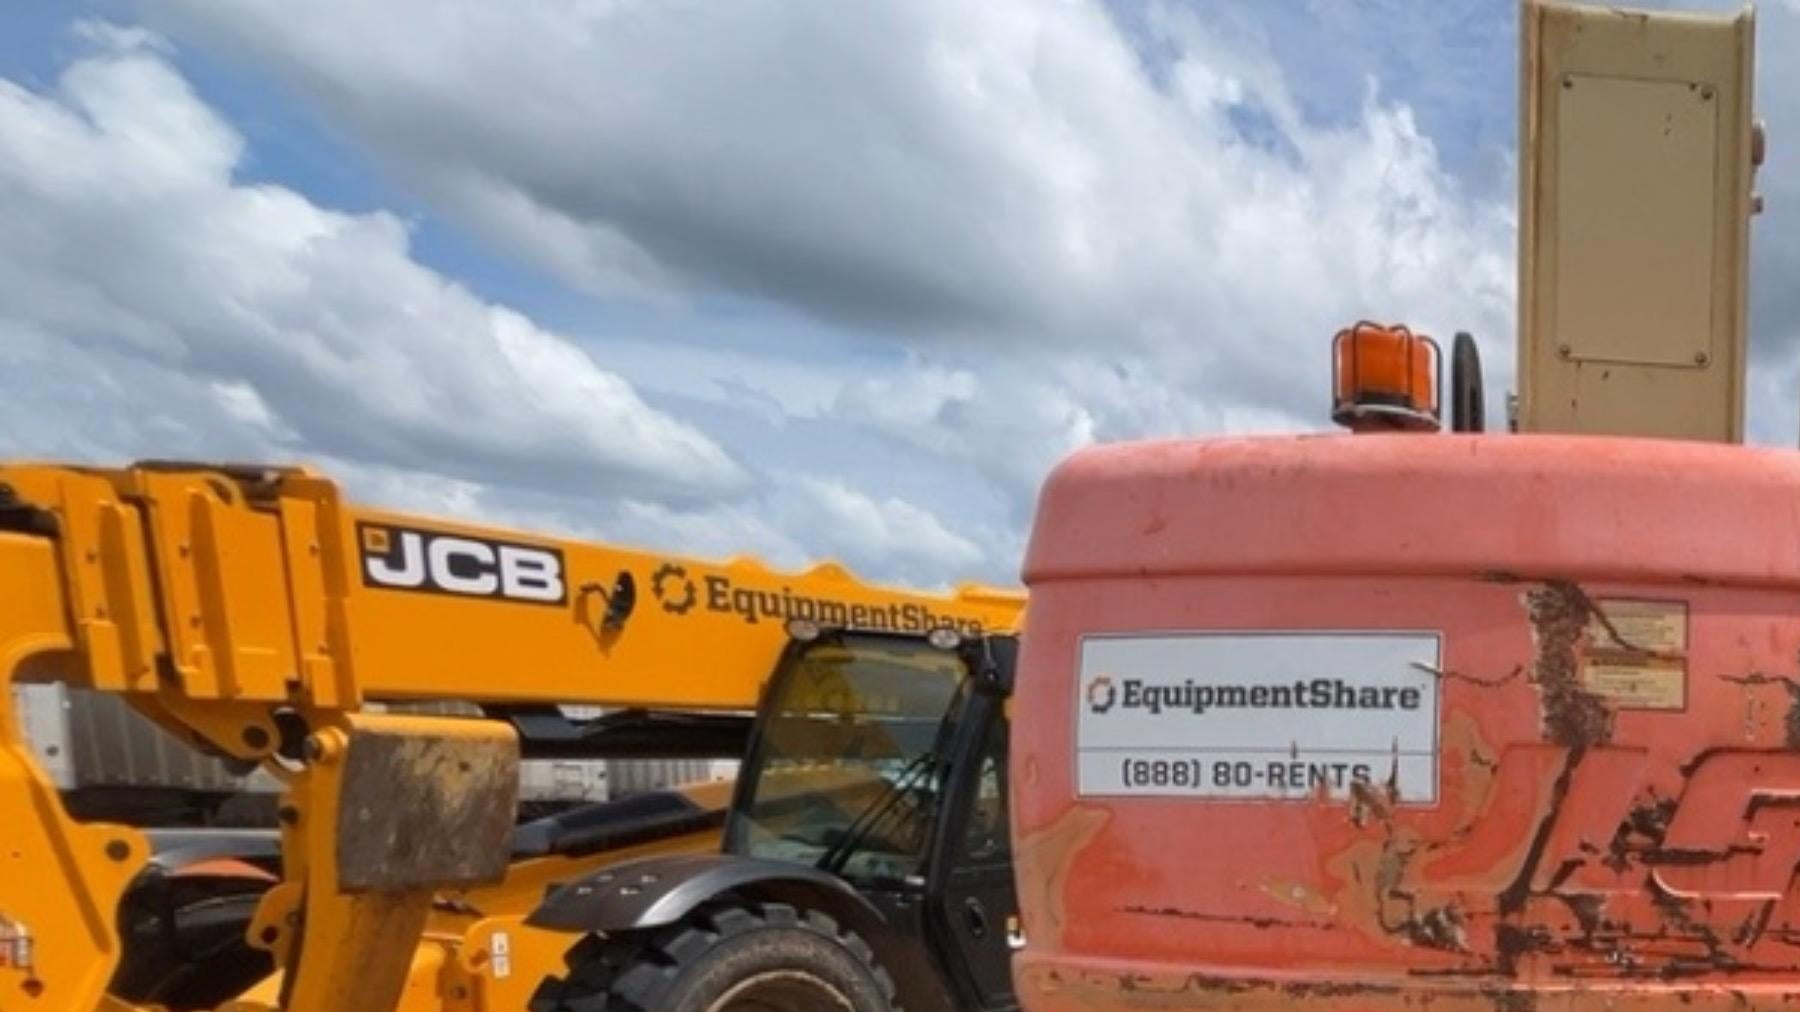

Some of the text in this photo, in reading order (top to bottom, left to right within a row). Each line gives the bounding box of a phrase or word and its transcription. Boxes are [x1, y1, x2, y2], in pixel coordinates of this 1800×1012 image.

[366, 530, 565, 602] JCB
[1121, 678, 1420, 715] EquipmentShare
[1122, 758, 1372, 789] (888) 80-RENTS
